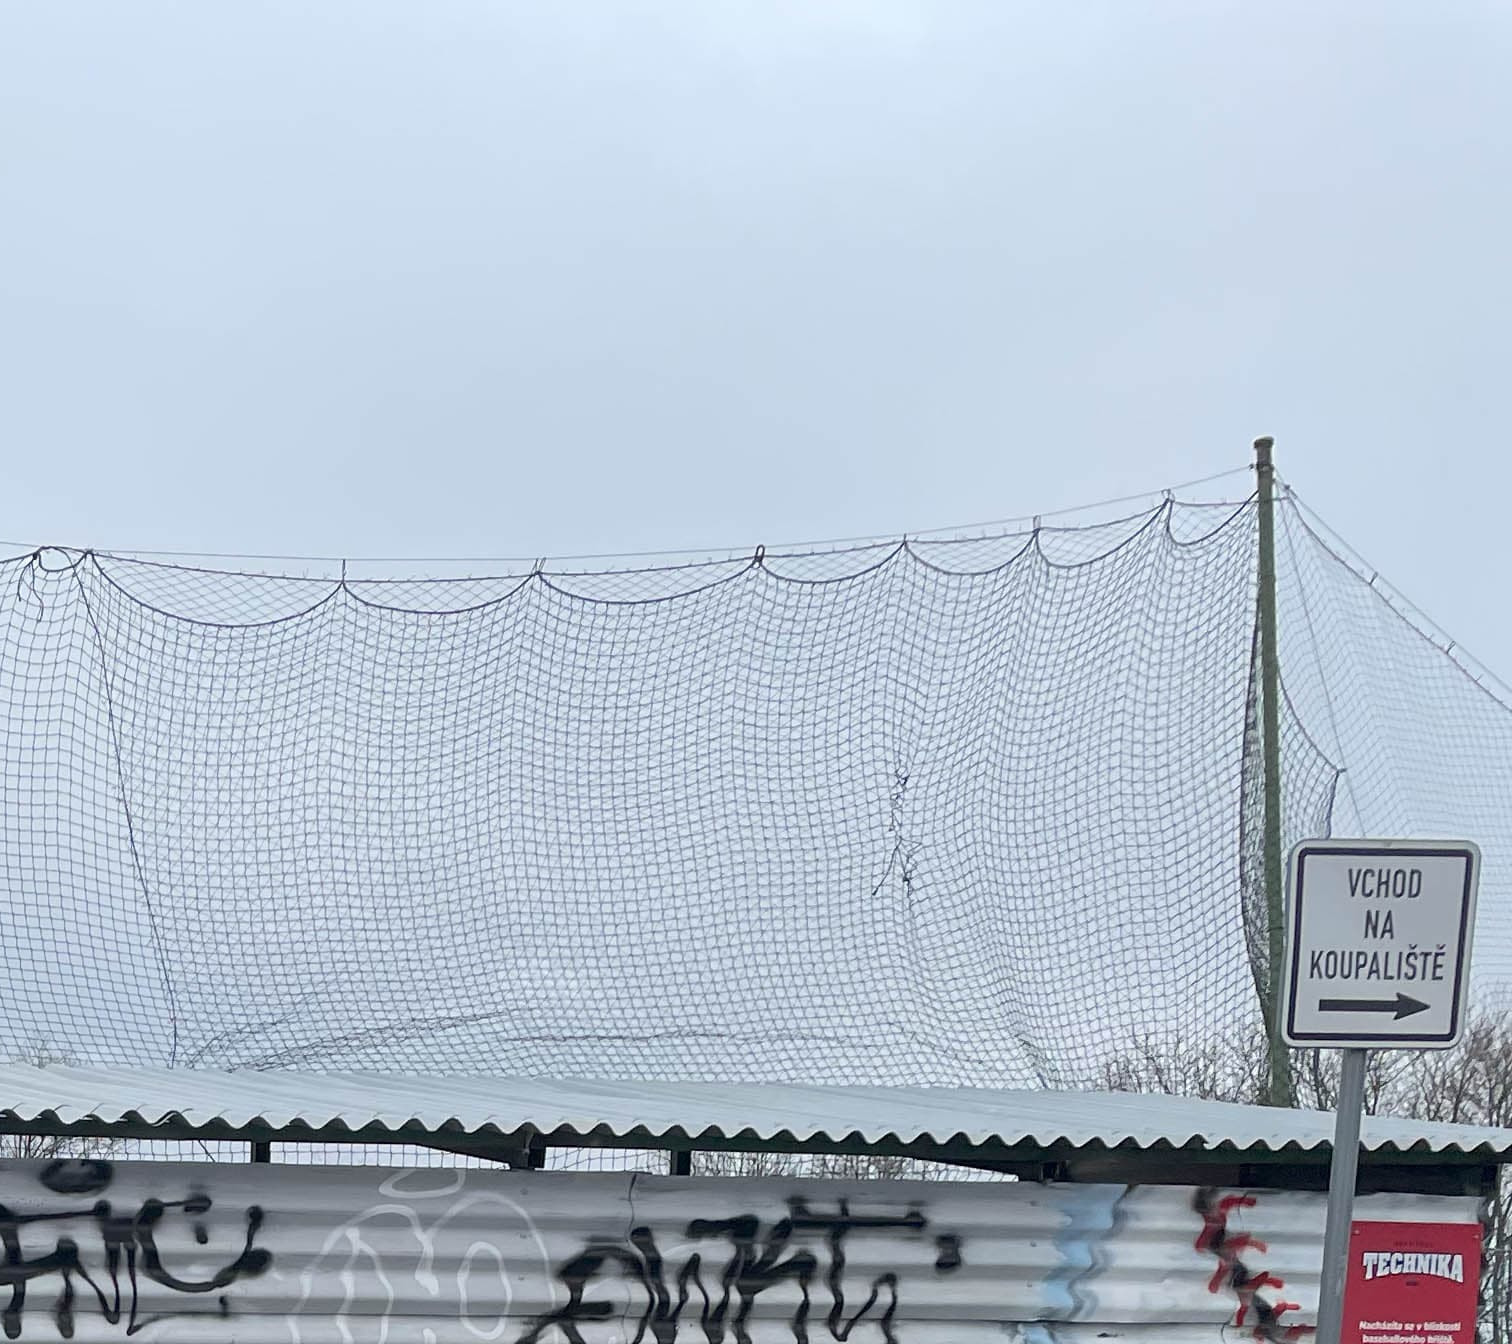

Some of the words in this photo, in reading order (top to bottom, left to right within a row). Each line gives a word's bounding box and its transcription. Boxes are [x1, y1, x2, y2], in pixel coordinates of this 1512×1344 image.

[1348, 868, 1422, 899] VCHOD
[1363, 909, 1395, 940] NA
[1309, 943, 1447, 981] KOUPALIŠTĚ
[1362, 1251, 1464, 1284] TECHNIKA
